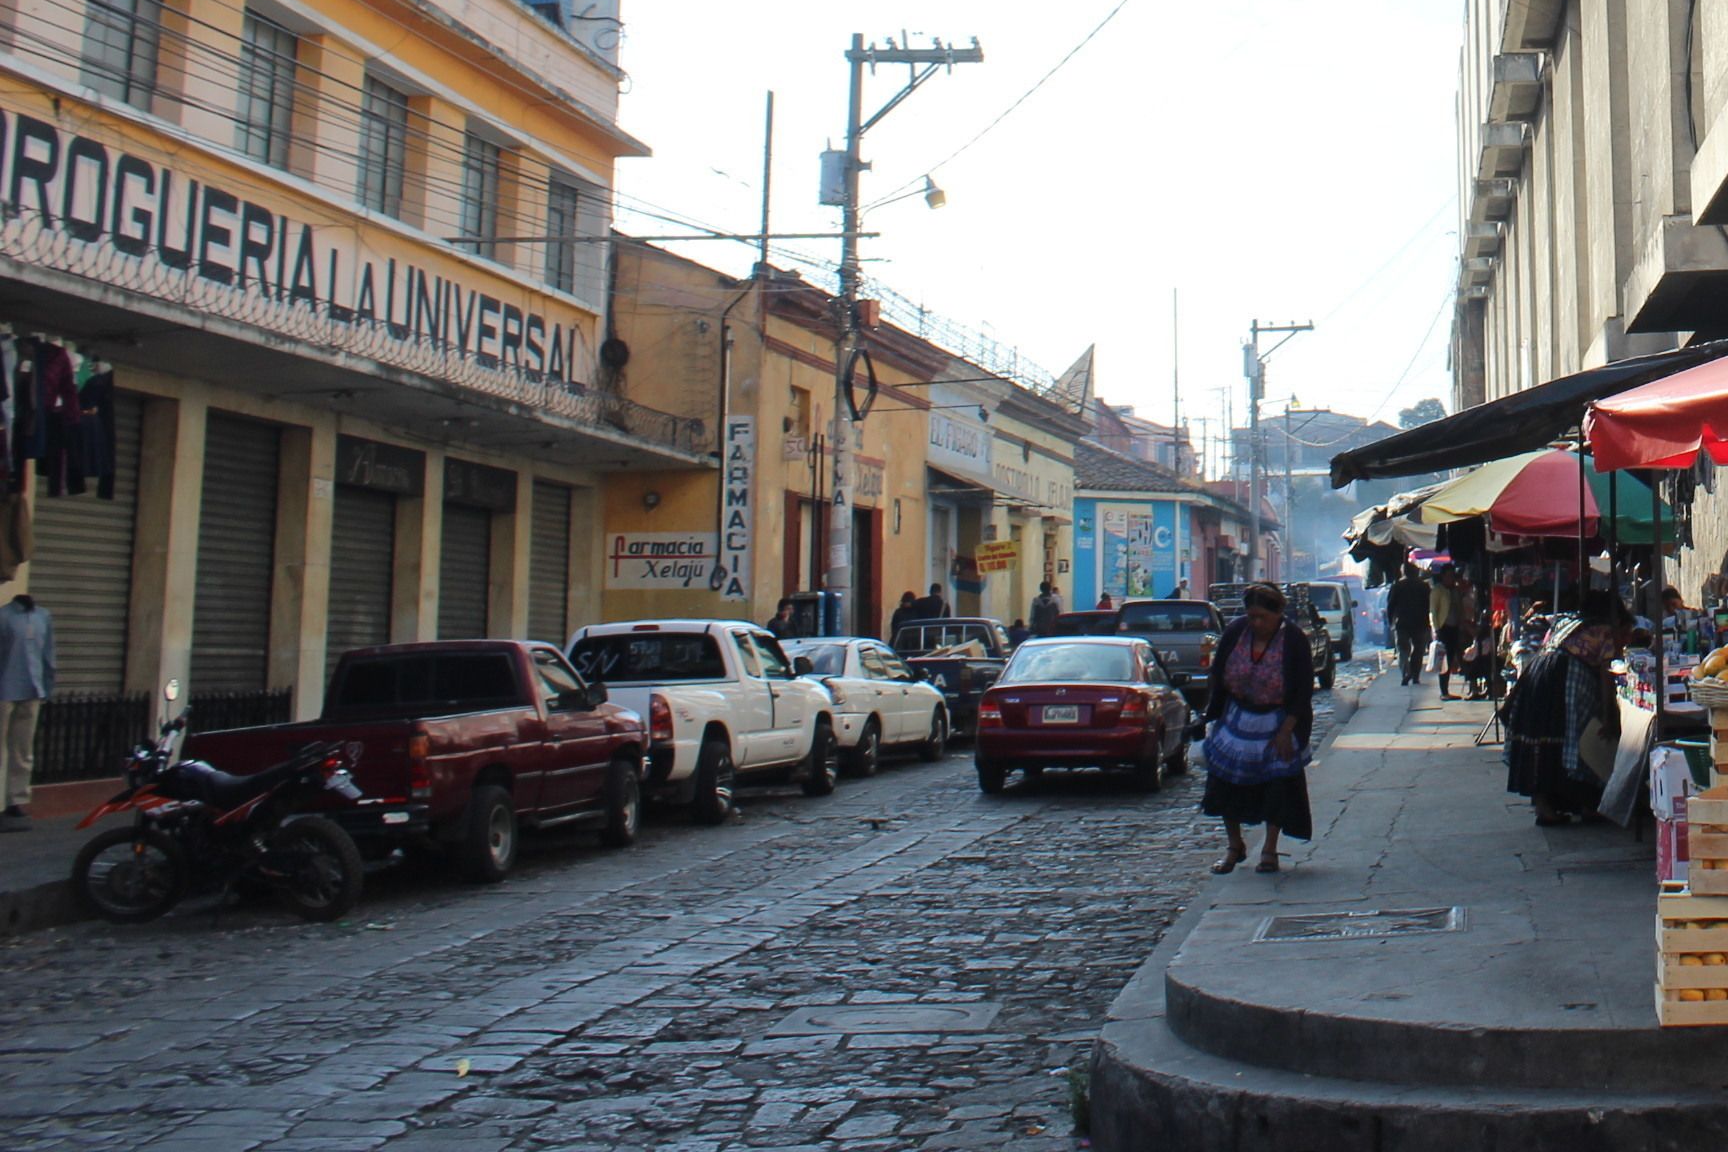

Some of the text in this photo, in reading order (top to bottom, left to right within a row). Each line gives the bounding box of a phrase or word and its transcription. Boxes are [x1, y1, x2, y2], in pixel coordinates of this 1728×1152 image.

[0, 105, 587, 397] ROGUERIA LA UNIVERSAL
[726, 423, 749, 596] FARMACIA
